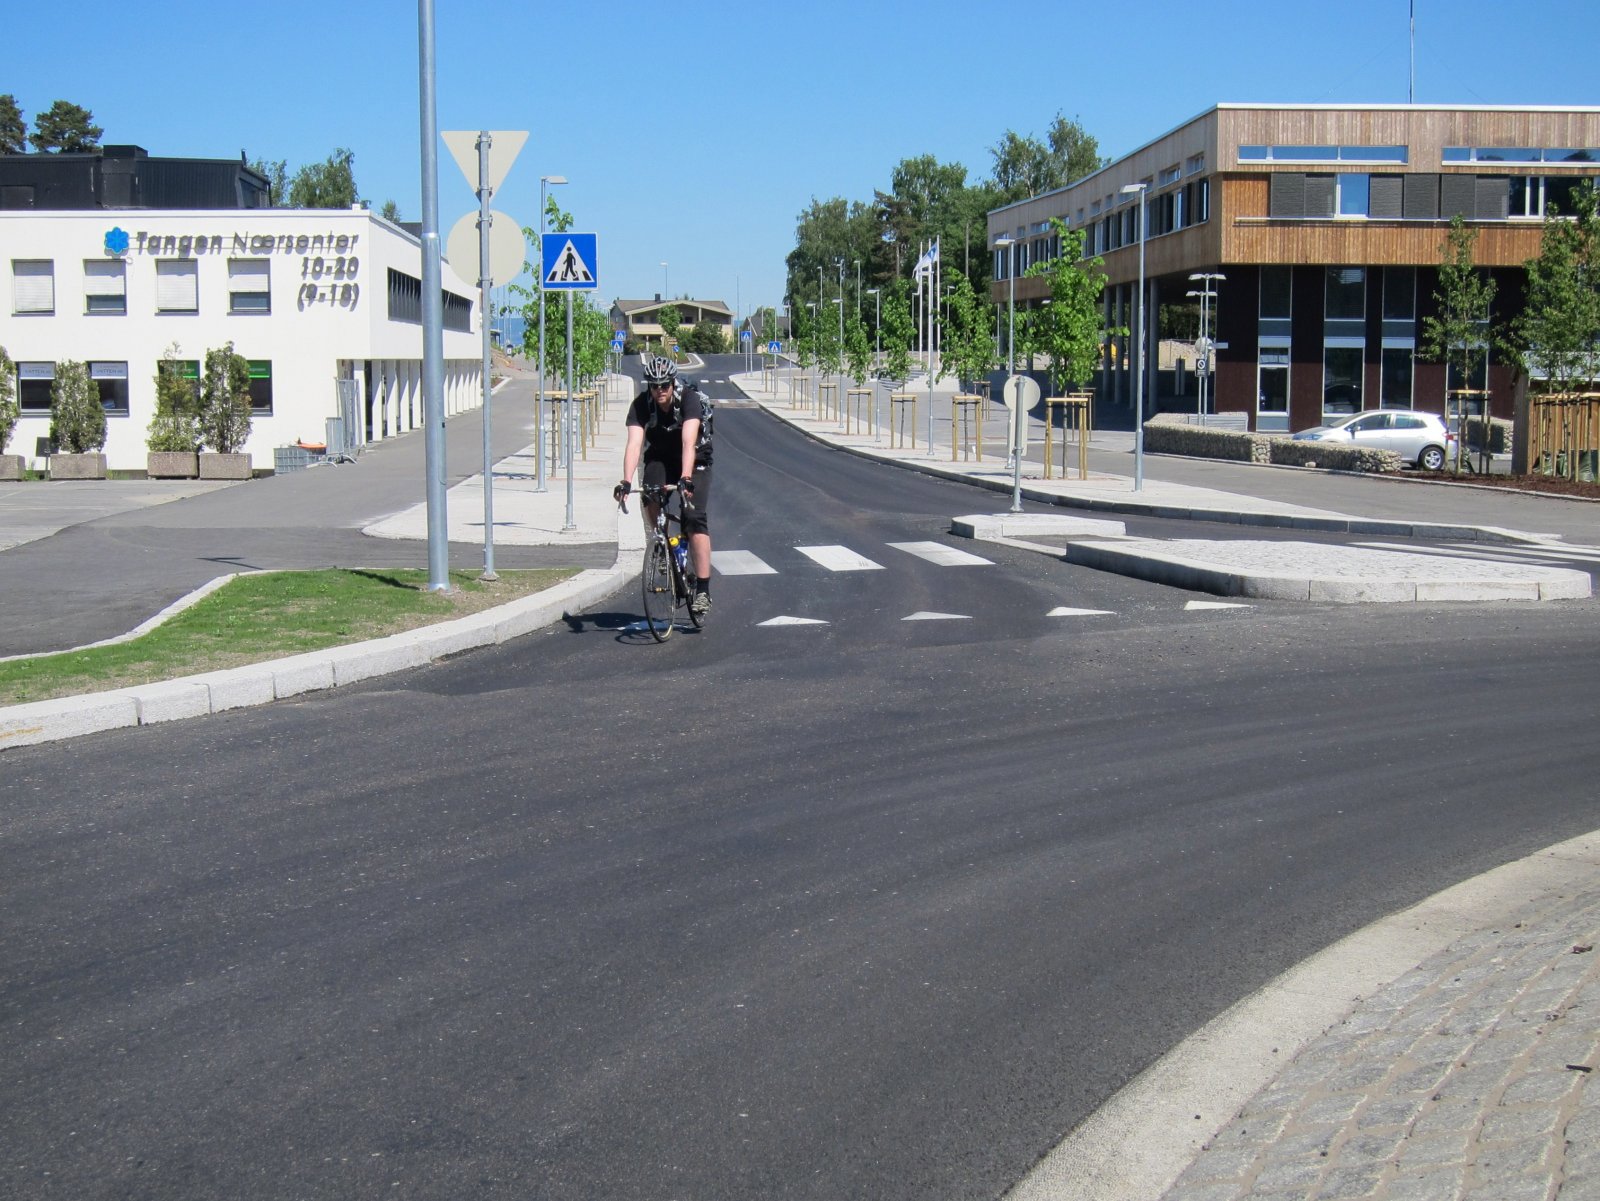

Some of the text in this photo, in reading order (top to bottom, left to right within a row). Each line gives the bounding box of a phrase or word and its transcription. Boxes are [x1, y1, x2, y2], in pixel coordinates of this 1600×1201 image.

[136, 230, 359, 258] Tangen Nærsenter
[301, 256, 359, 280] 10-20
